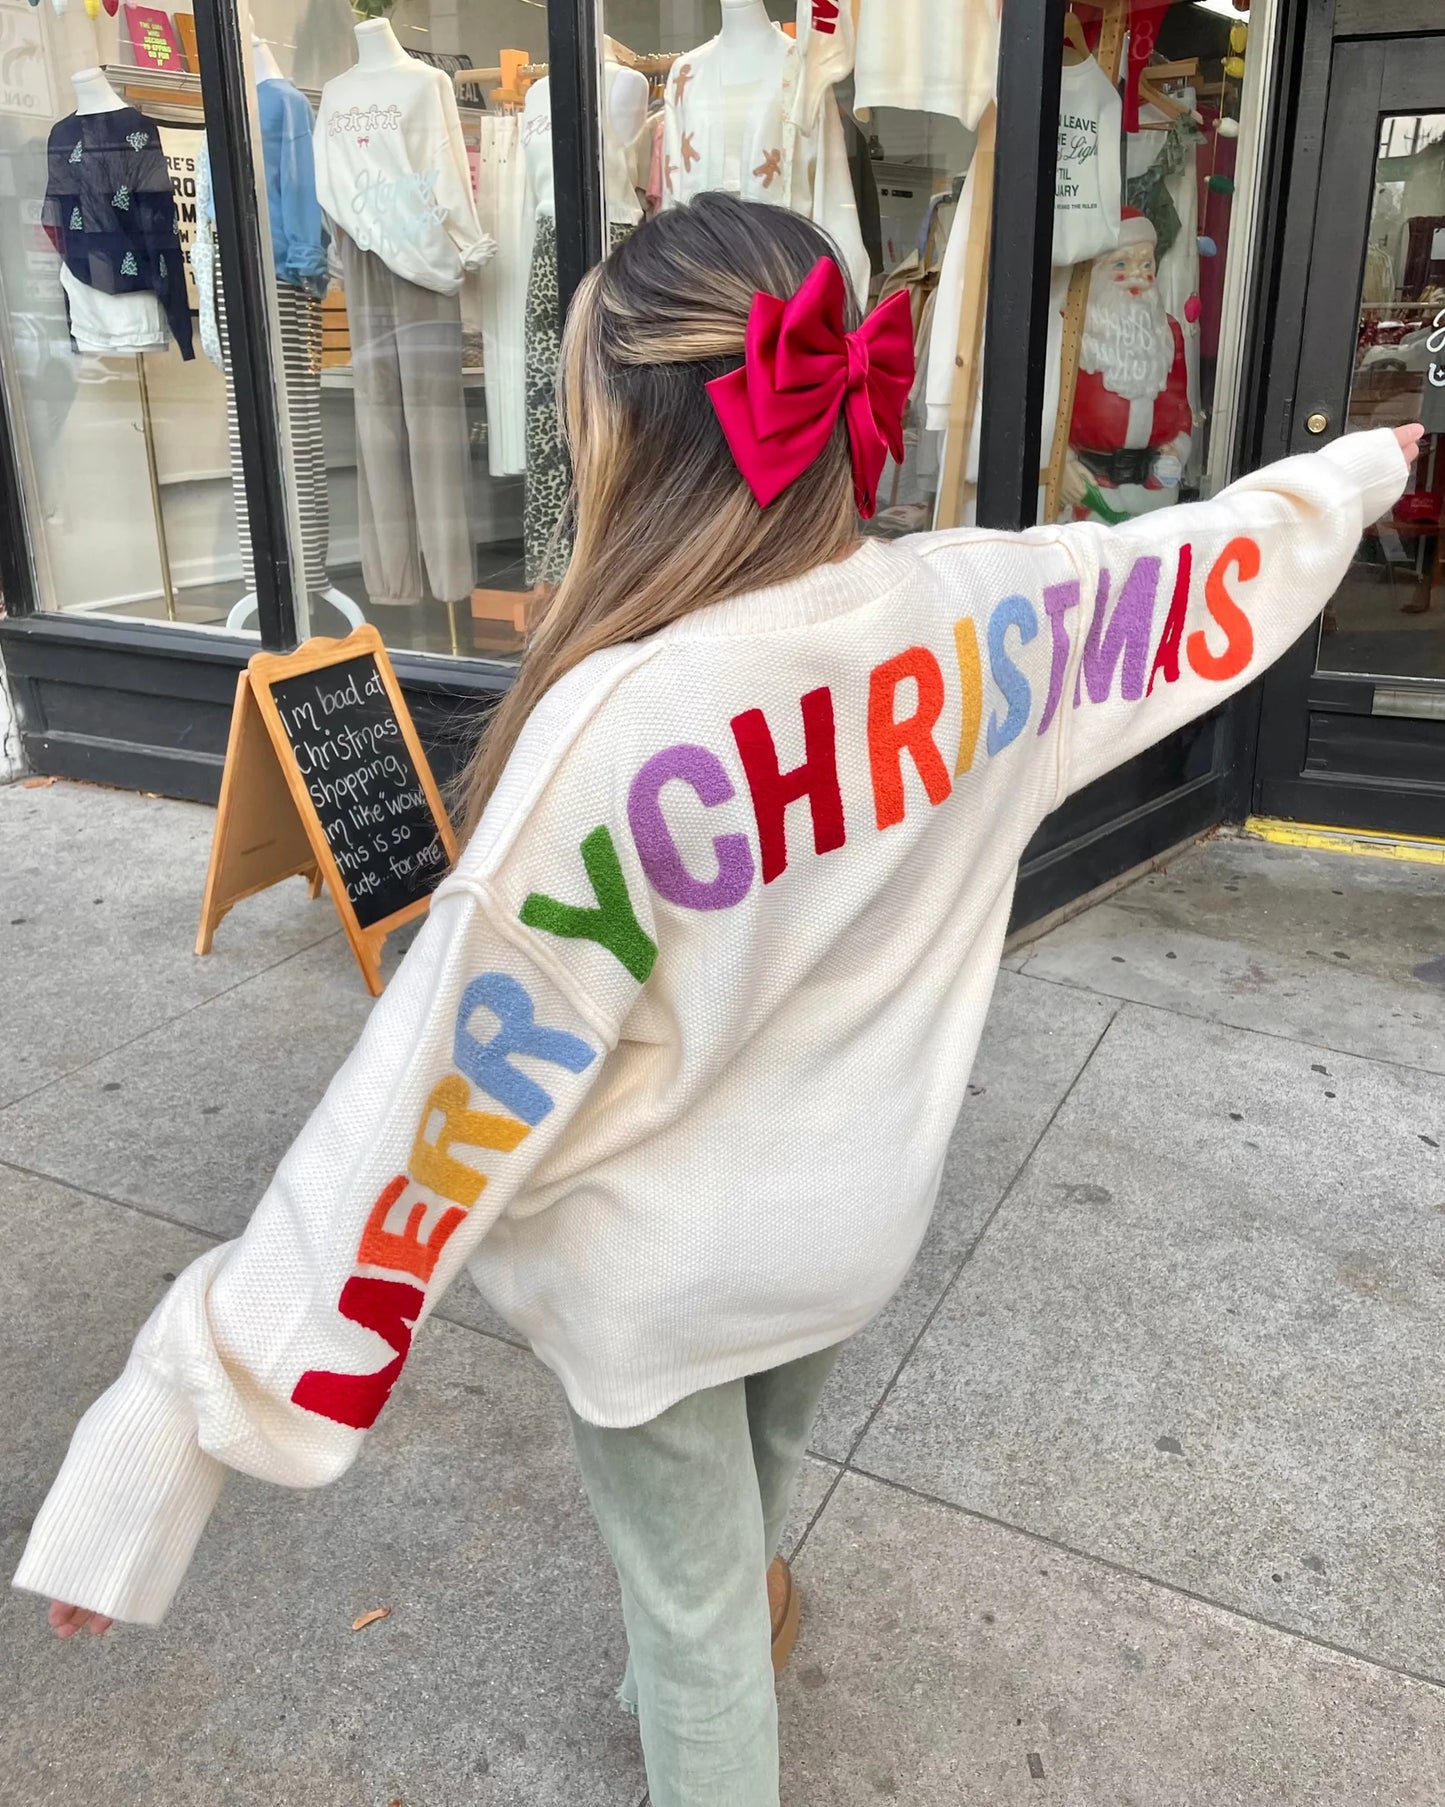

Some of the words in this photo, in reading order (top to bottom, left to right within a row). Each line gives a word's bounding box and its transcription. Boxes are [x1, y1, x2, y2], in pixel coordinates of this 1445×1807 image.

[1063, 114, 1097, 134] LEAVE
[164, 156, 195, 172] RE'S
[1063, 134, 1098, 165] Ligh
[315, 673, 365, 716] bad
[364, 668, 385, 696] at
[293, 718, 398, 775] Christmas
[348, 803, 385, 831] like
[333, 844, 370, 876] this
[367, 832, 389, 853] is
[391, 824, 411, 845] so
[389, 856, 412, 880] for
[416, 843, 442, 867] me
[290, 824, 659, 1430] MERRY
[626, 536, 1261, 911] CHRISTMAS
